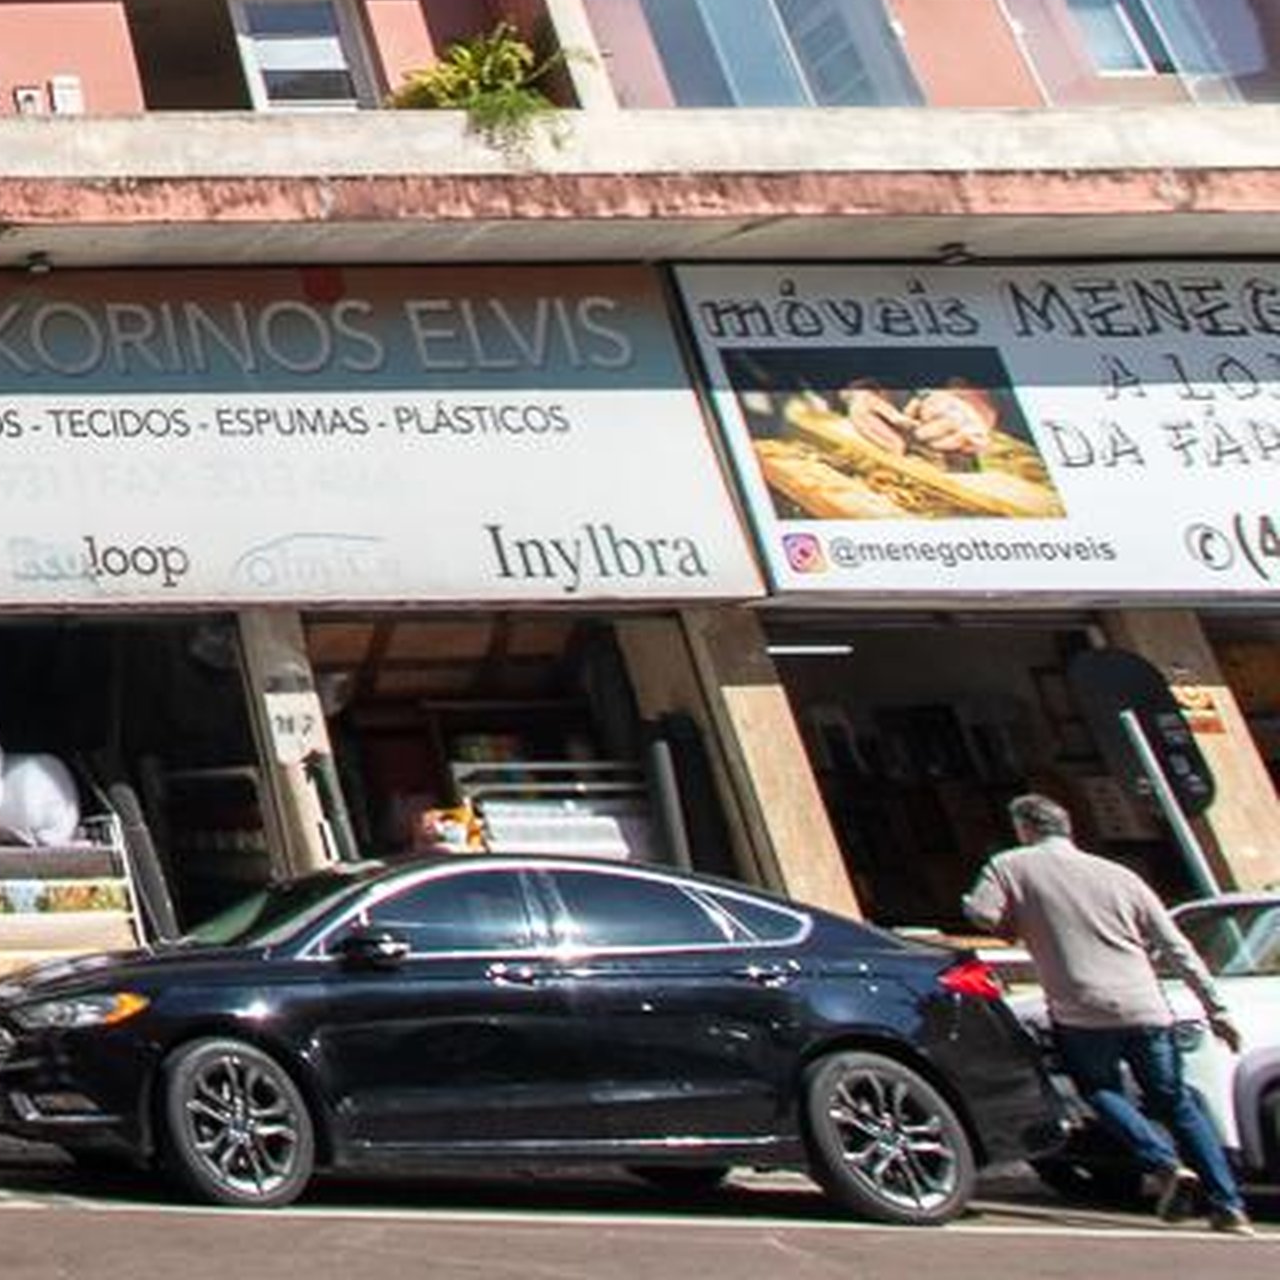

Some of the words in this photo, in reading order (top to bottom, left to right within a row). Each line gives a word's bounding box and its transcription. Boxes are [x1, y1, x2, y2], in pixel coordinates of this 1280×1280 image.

[700, 278, 980, 338] móveis
[409, 296, 636, 373] ELVIS
[1098, 352, 1146, 400] A
[1162, 350, 1280, 400] LO
[52, 407, 190, 438] TECIDOS
[218, 404, 369, 436] ESPUMAS
[395, 400, 571, 435] PLÁSTICOS
[1043, 420, 1144, 468] DA
[483, 523, 708, 592] Inylbra
[828, 536, 1117, 568] @menegottomoveis
